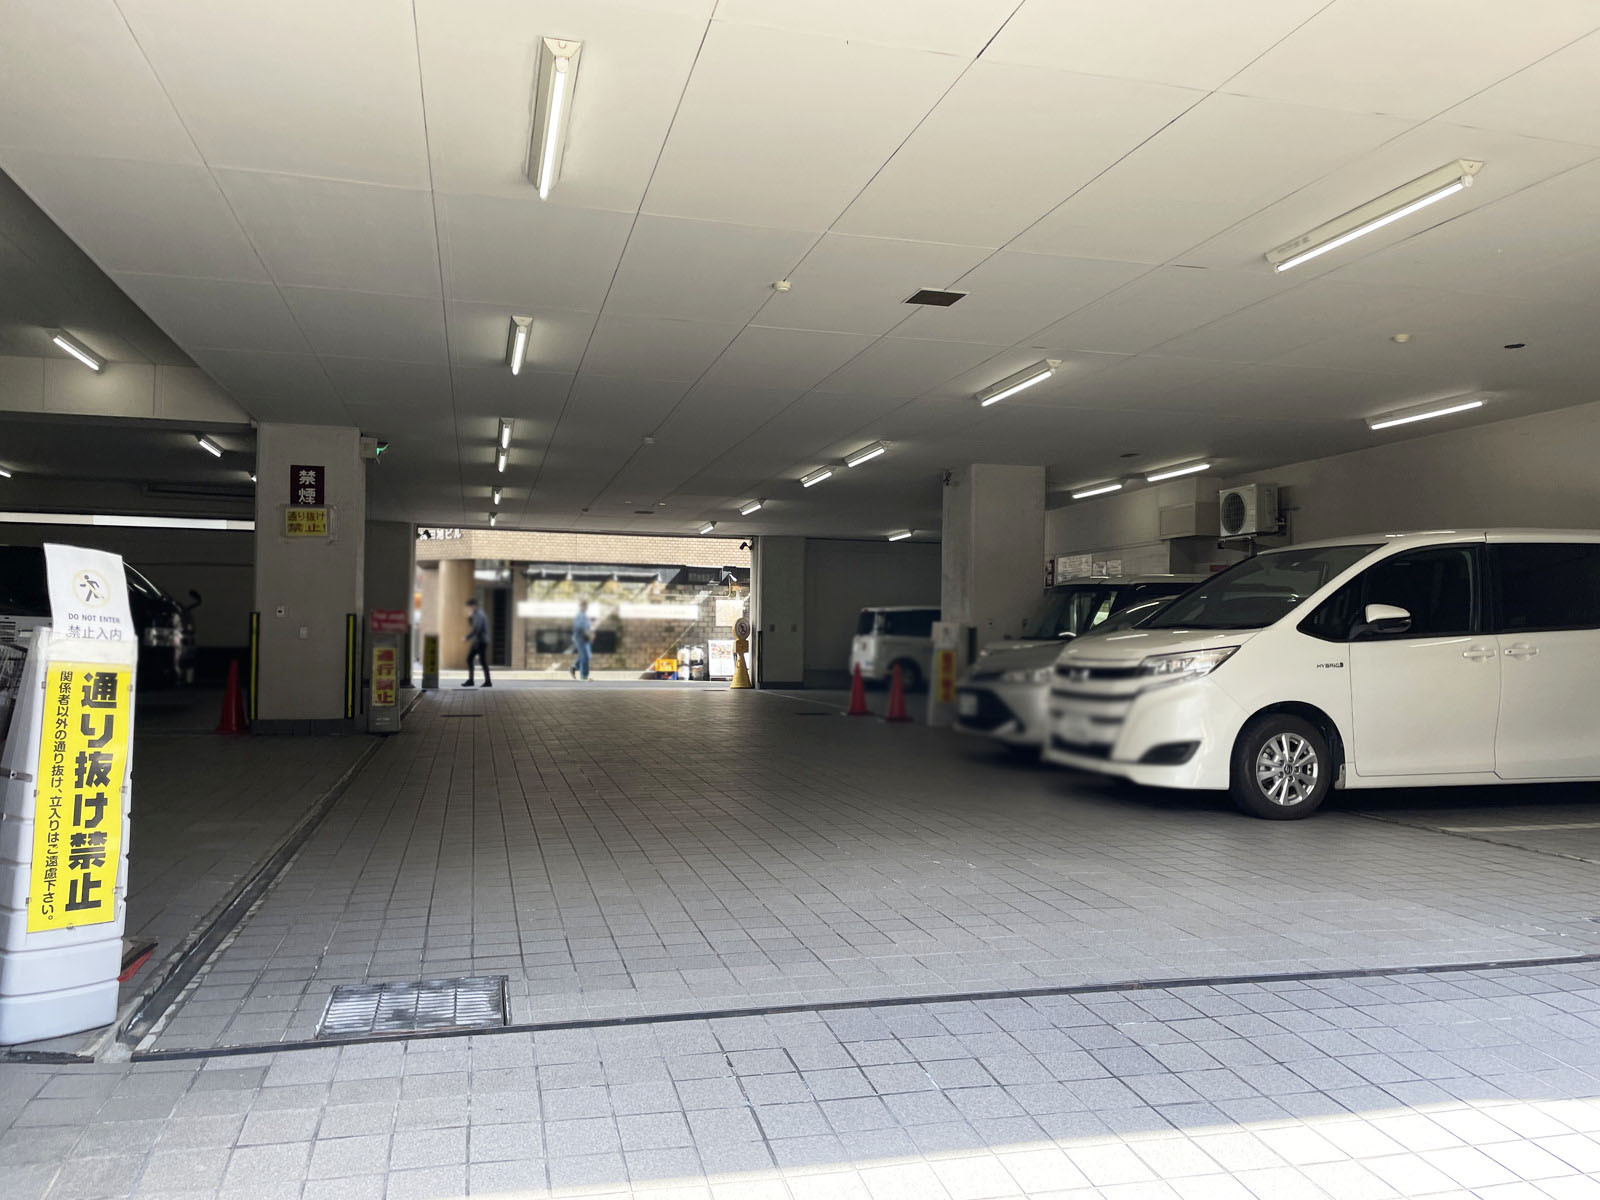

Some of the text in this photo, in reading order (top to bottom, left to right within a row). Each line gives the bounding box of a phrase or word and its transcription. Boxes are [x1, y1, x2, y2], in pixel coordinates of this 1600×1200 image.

[298, 469, 316, 505] 禁煙
[66, 624, 122, 641] 禁止入内
[82, 614, 96, 622] NOT
[99, 615, 120, 624] ENTER
[41, 670, 73, 921] 関係者以外の通り抜け、立入りはご遠慮下さい。
[64, 671, 118, 912] 通り抜け禁止
